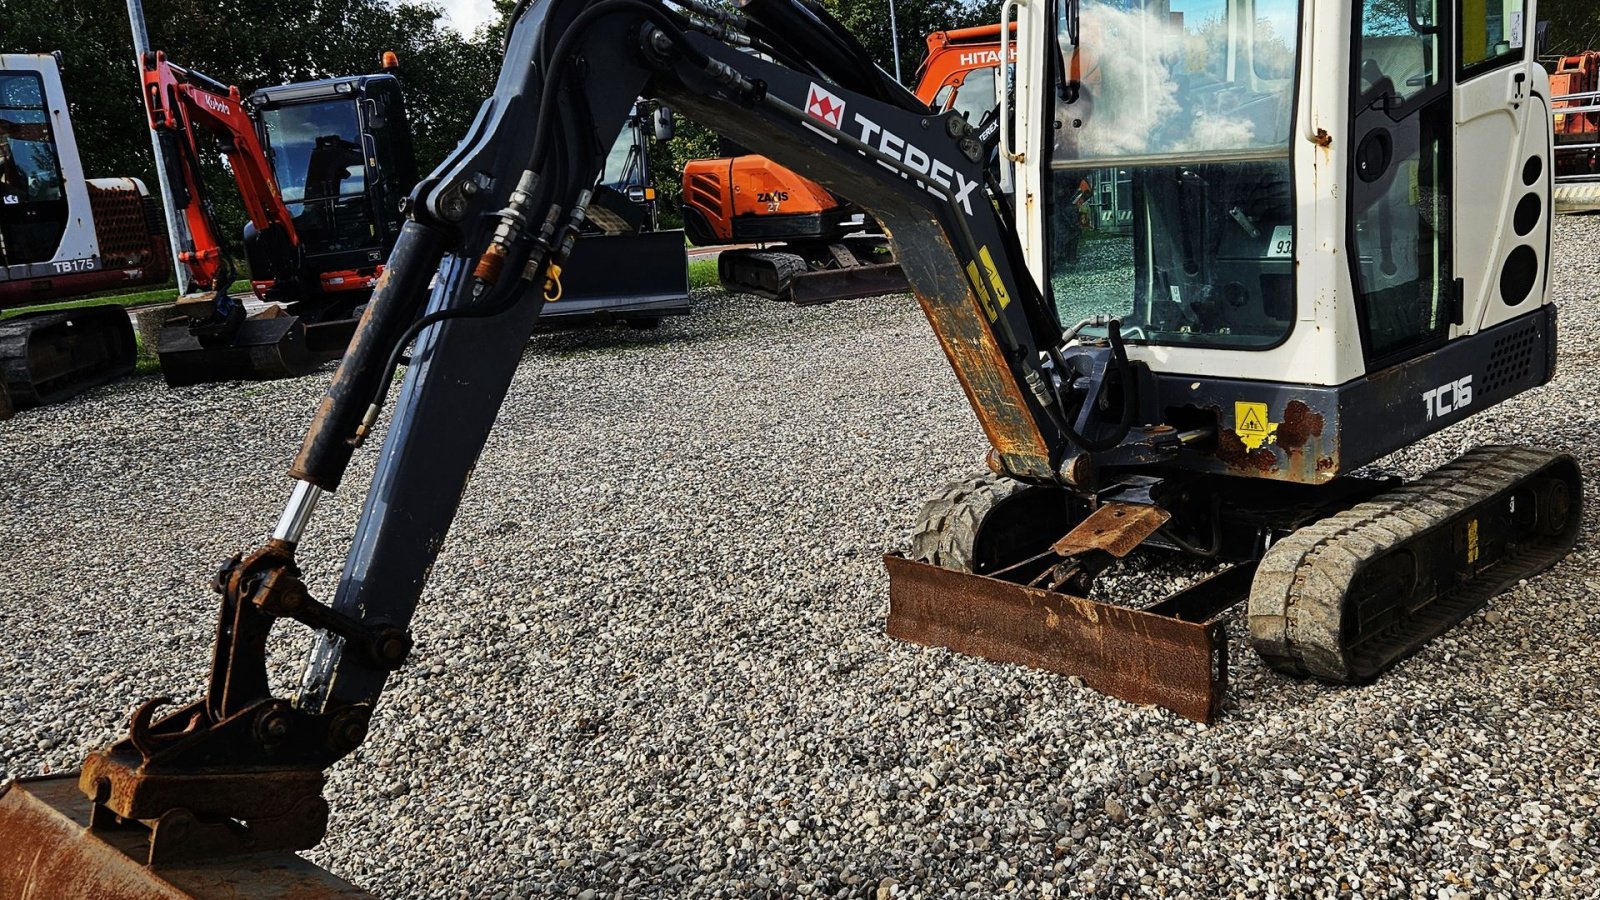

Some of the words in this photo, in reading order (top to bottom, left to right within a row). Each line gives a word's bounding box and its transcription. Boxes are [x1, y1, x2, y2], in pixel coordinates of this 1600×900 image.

[960, 48, 1018, 66] HITAH
[205, 94, 230, 115] Kubota
[979, 119, 999, 142] TEREX
[854, 112, 979, 216] TEREX
[757, 190, 789, 203] ZAXIS
[767, 202, 780, 211] 27
[1276, 240, 1292, 254] 93
[53, 259, 95, 273] TB175
[1422, 374, 1473, 422] TC16
